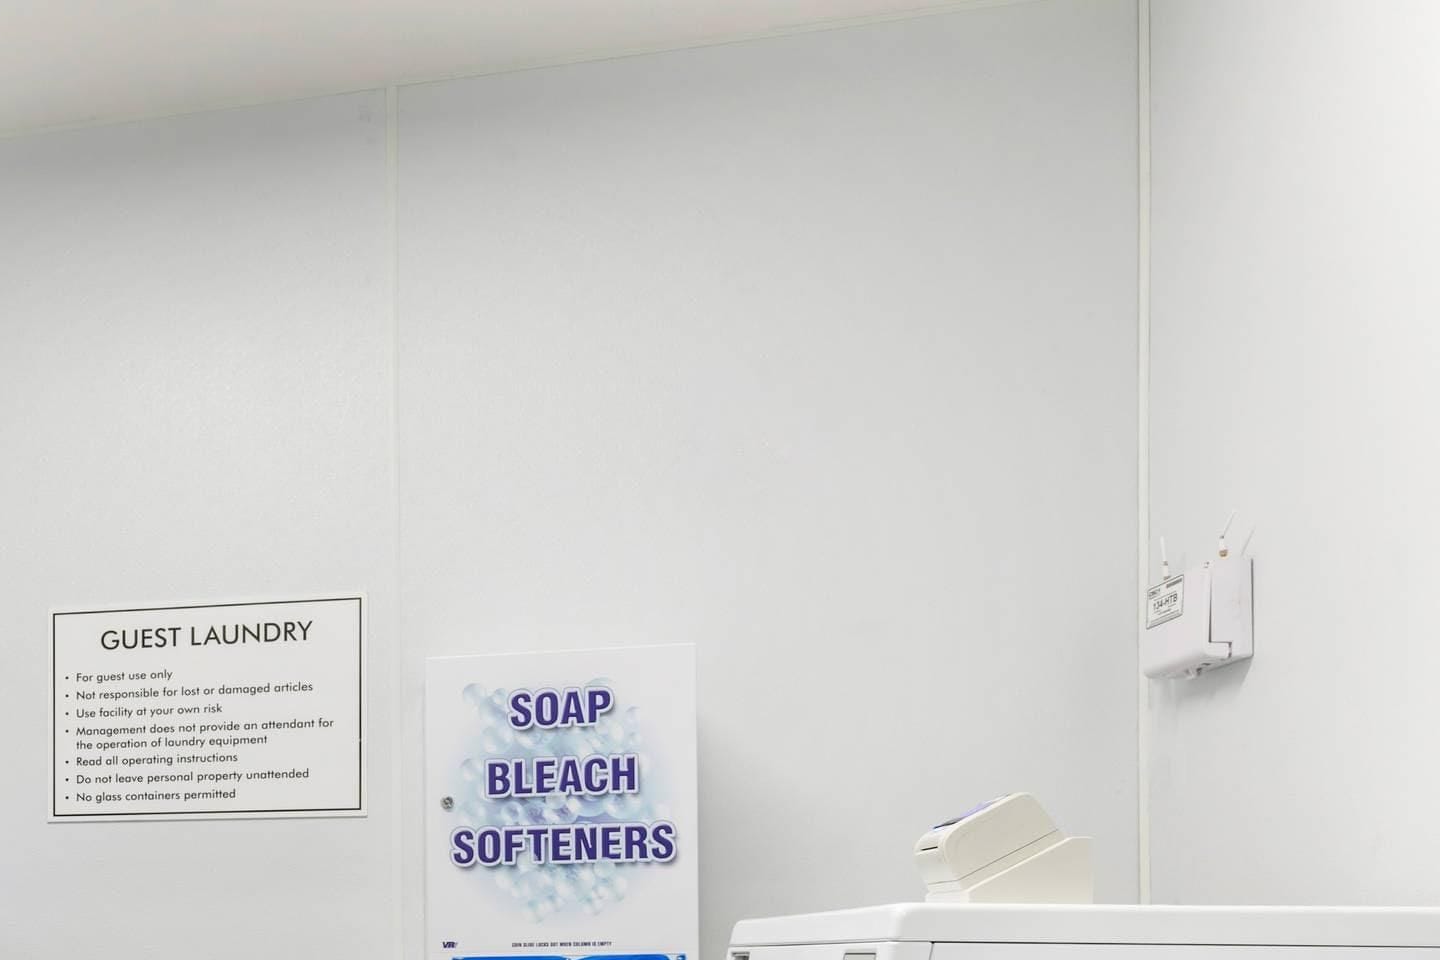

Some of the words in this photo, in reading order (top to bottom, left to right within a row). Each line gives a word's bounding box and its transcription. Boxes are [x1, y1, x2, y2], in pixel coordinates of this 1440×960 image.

[101, 627, 181, 650] GUEST
[190, 620, 313, 646] LAUNDRY
[76, 673, 93, 683] For
[96, 671, 125, 684] guest
[128, 671, 147, 680] use
[150, 669, 173, 680] only
[76, 691, 96, 701] Not
[99, 688, 160, 702] responsible
[162, 687, 178, 697] for
[181, 686, 200, 696] lost
[203, 687, 215, 695] or
[218, 683, 270, 695] damaged
[273, 682, 313, 693] articles
[76, 709, 96, 718] Use
[99, 706, 133, 719] facility
[136, 707, 147, 716] at
[149, 706, 174, 717] your
[177, 706, 200, 715] own
[203, 704, 222, 714] risk
[510, 690, 611, 727] SOAP
[76, 725, 147, 737] Management
[149, 724, 175, 734] does
[178, 723, 196, 733] not
[199, 721, 240, 734] provide
[243, 722, 258, 730] an
[261, 719, 315, 730] attendant
[318, 718, 334, 728] for
[76, 740, 93, 750] the
[96, 738, 148, 751] operation
[151, 737, 162, 747] of
[165, 736, 206, 748] laundry
[209, 734, 268, 748] equipment
[76, 756, 102, 767] Read
[105, 755, 119, 765] all
[122, 754, 174, 768] operating
[176, 753, 238, 764] instructions
[76, 775, 91, 784] Do
[94, 775, 112, 784] not
[115, 773, 144, 783] leave
[147, 772, 194, 785] personal
[196, 771, 243, 783] property
[246, 769, 310, 779] unattended
[487, 756, 636, 796] BLEACH
[76, 792, 93, 802] No
[96, 791, 122, 804] glass
[125, 790, 181, 801] containers
[184, 789, 236, 802] permitted
[453, 824, 674, 865] SOFTENERS
